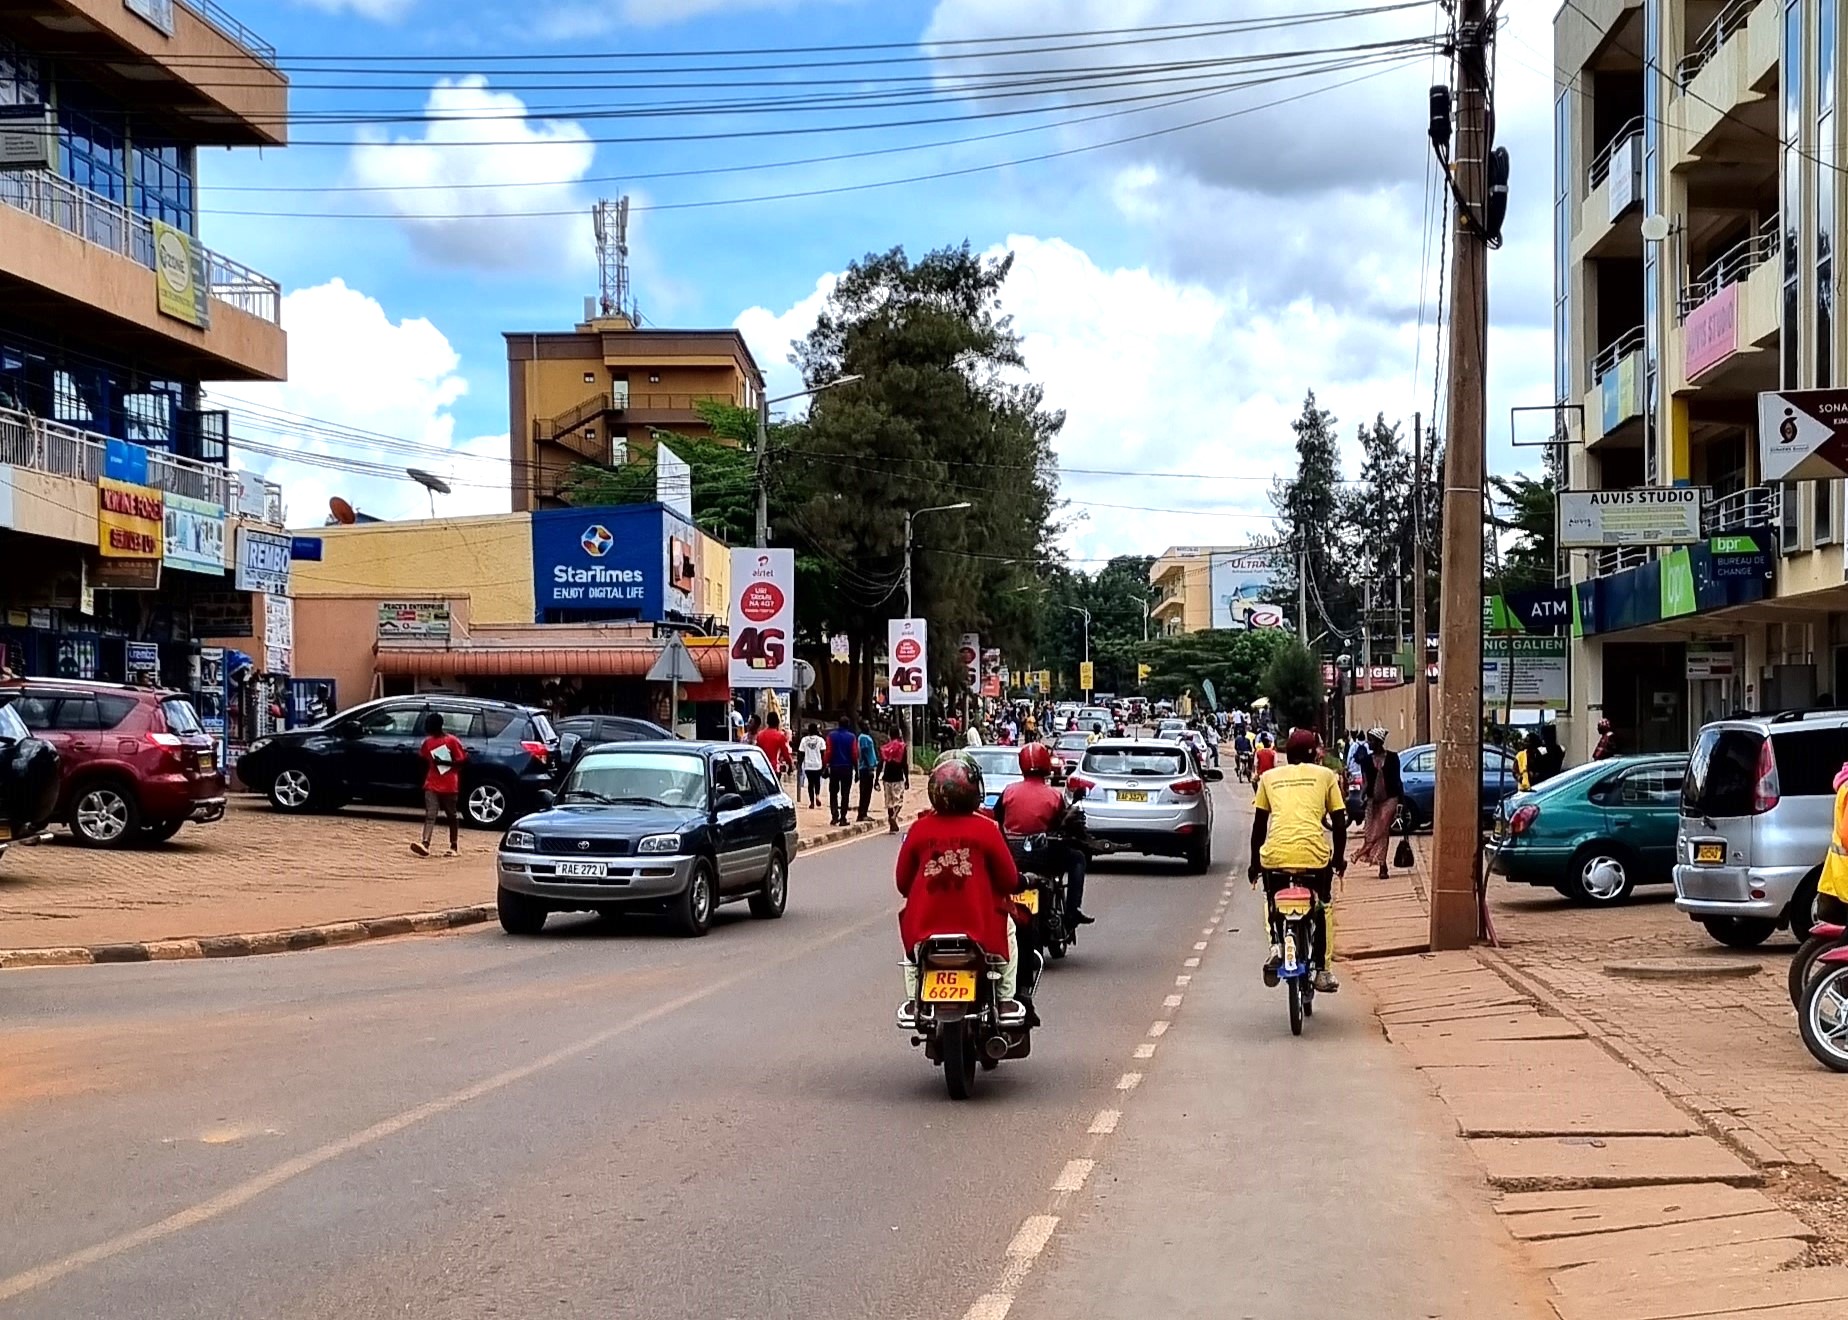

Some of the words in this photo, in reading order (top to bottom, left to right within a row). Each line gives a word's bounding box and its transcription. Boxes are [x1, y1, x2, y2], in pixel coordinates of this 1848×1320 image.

[1590, 493, 1634, 504] AUVIS
[1638, 490, 1694, 503] STUDIO
[1717, 538, 1741, 552] bpr
[1231, 560, 1266, 569] ULTRA
[1717, 557, 1752, 566] BUREAU
[1754, 556, 1765, 564] DE
[553, 565, 643, 582] StarTimes
[752, 568, 774, 577] airtel
[1717, 567, 1753, 576] CHANGE
[553, 587, 585, 598] ENJOY
[588, 586, 624, 598] DIGITAL
[626, 586, 644, 598] LIFE
[1531, 601, 1567, 617] ATM
[731, 627, 785, 669] 4G
[1512, 640, 1563, 650] GALIEN
[1347, 666, 1397, 678] UGER
[891, 667, 923, 692] 4G
[563, 864, 579, 874] RAE
[582, 865, 598, 875] 272
[599, 865, 605, 875] V
[936, 972, 957, 985] RG
[929, 986, 969, 999] 667P
